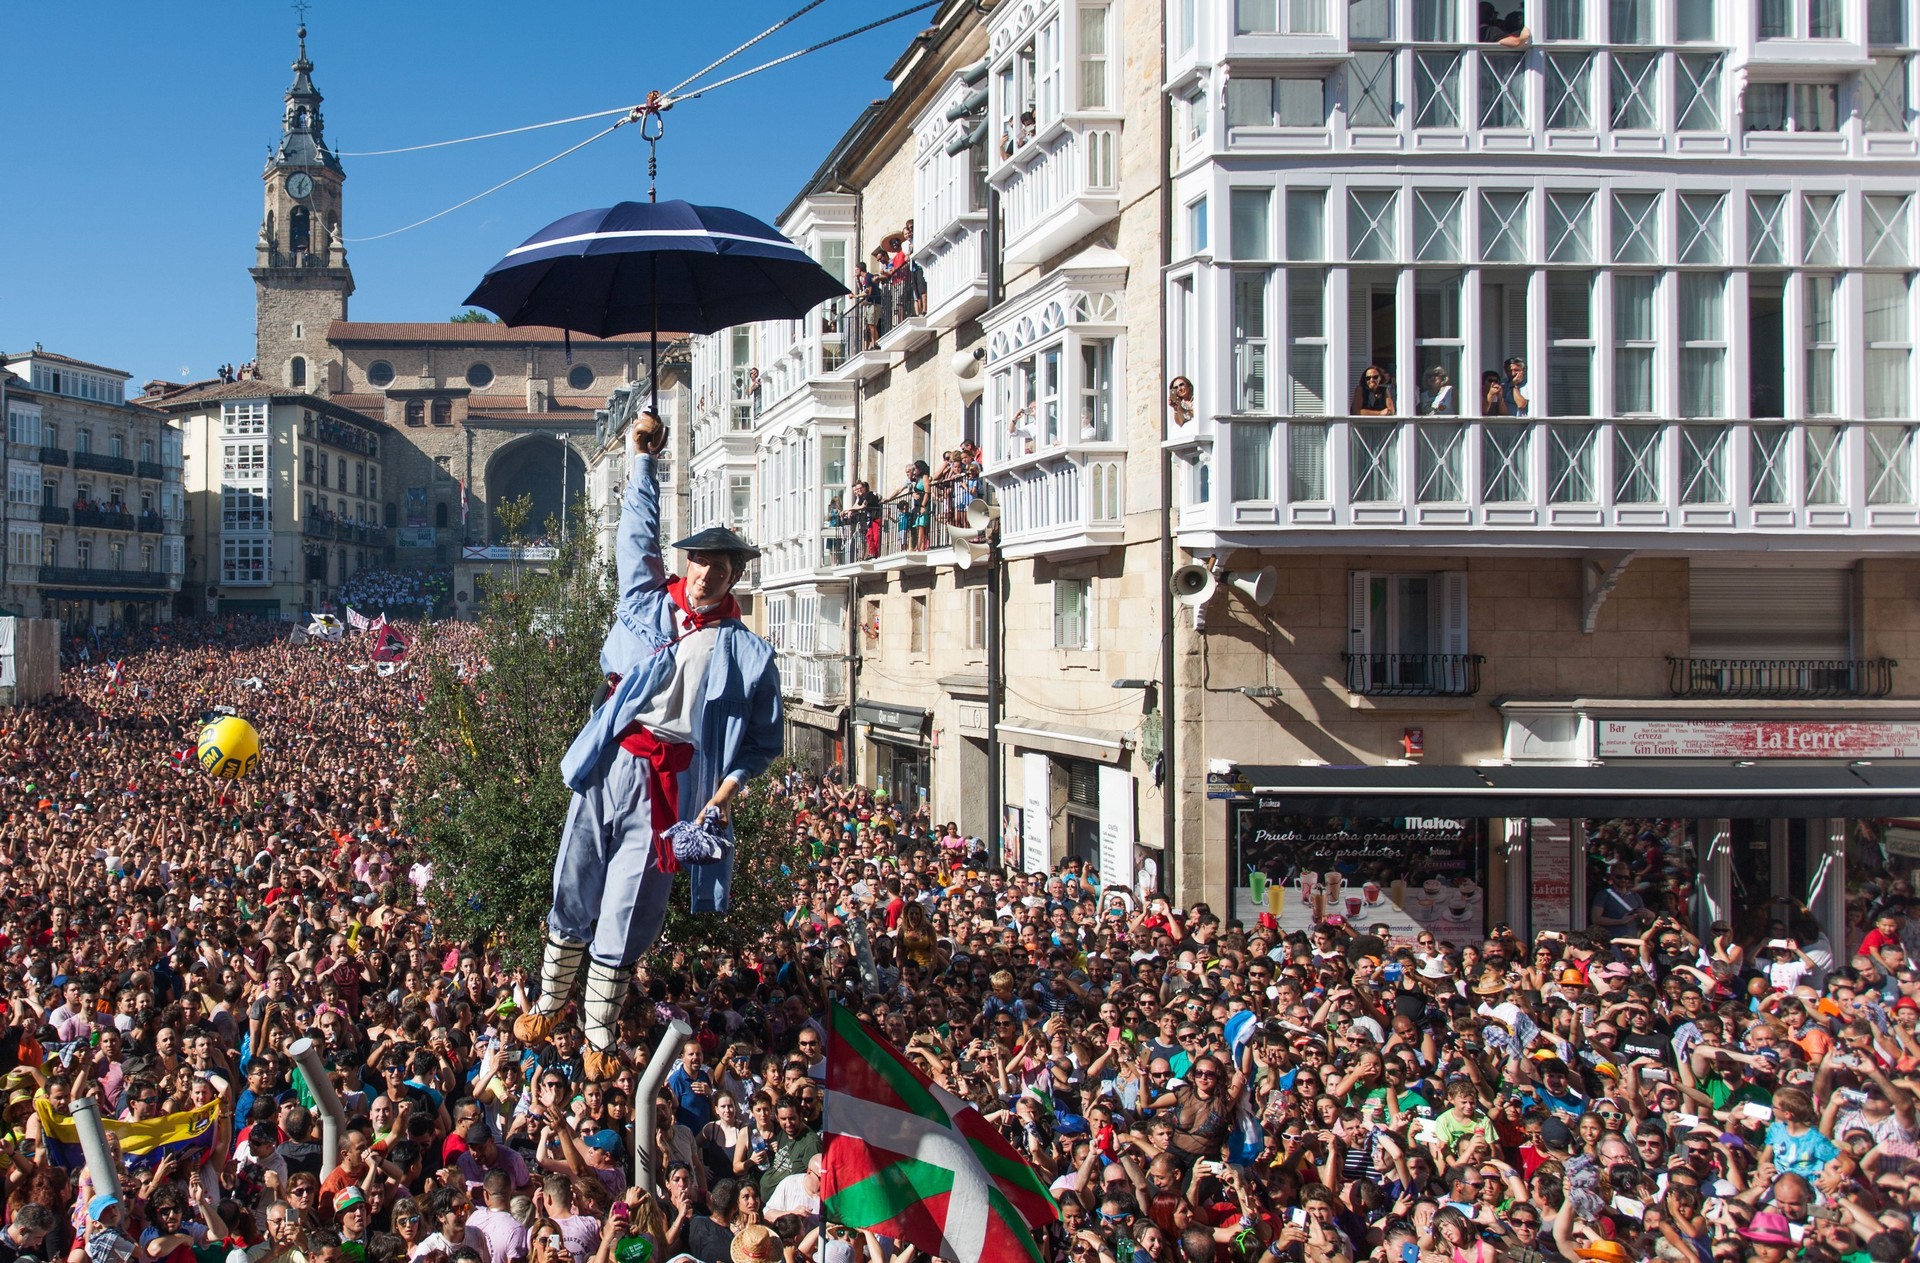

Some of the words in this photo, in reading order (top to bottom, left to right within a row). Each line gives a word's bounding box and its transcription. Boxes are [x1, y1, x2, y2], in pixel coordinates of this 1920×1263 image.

[1609, 723, 1626, 732] Bar
[1756, 727, 1781, 749] La
[1786, 727, 1846, 749] Ferre
[1634, 744, 1651, 754] Gin
[1653, 744, 1679, 754] Tonic
[202, 748, 219, 769] BM
[222, 762, 238, 779] BM
[1255, 829, 1303, 843] Prueba
[1308, 831, 1361, 842] nuestra
[1363, 833, 1398, 846] gran
[1400, 830, 1463, 842] variedad
[1315, 846, 1332, 857] de
[1533, 884, 1543, 894] La
[1545, 884, 1568, 894] Ferre
